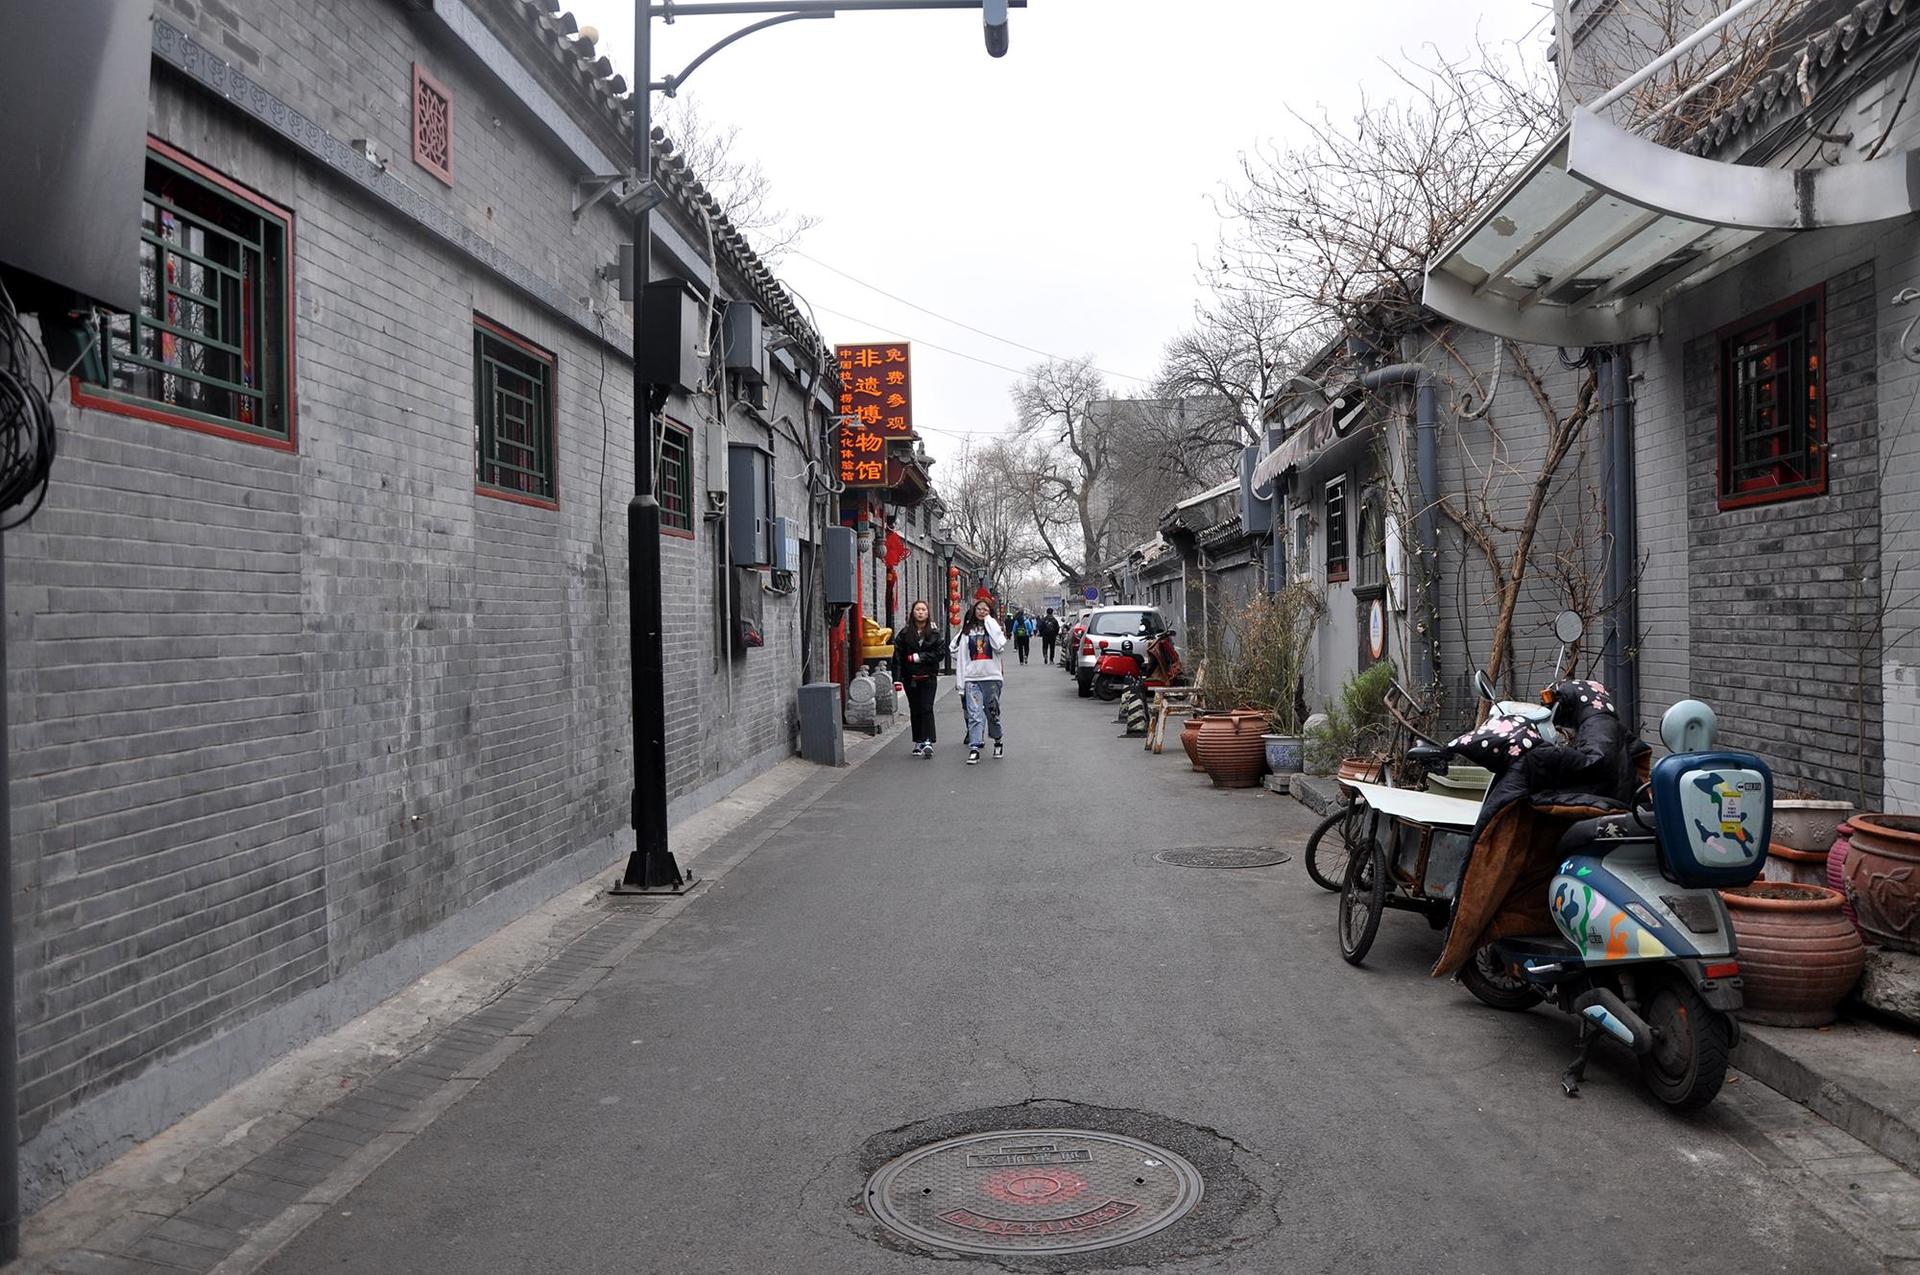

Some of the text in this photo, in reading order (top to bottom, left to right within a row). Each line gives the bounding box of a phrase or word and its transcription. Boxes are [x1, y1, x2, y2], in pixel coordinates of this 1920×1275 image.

[854, 348, 882, 480] 非遗博物馆
[886, 348, 907, 431] 免费参观
